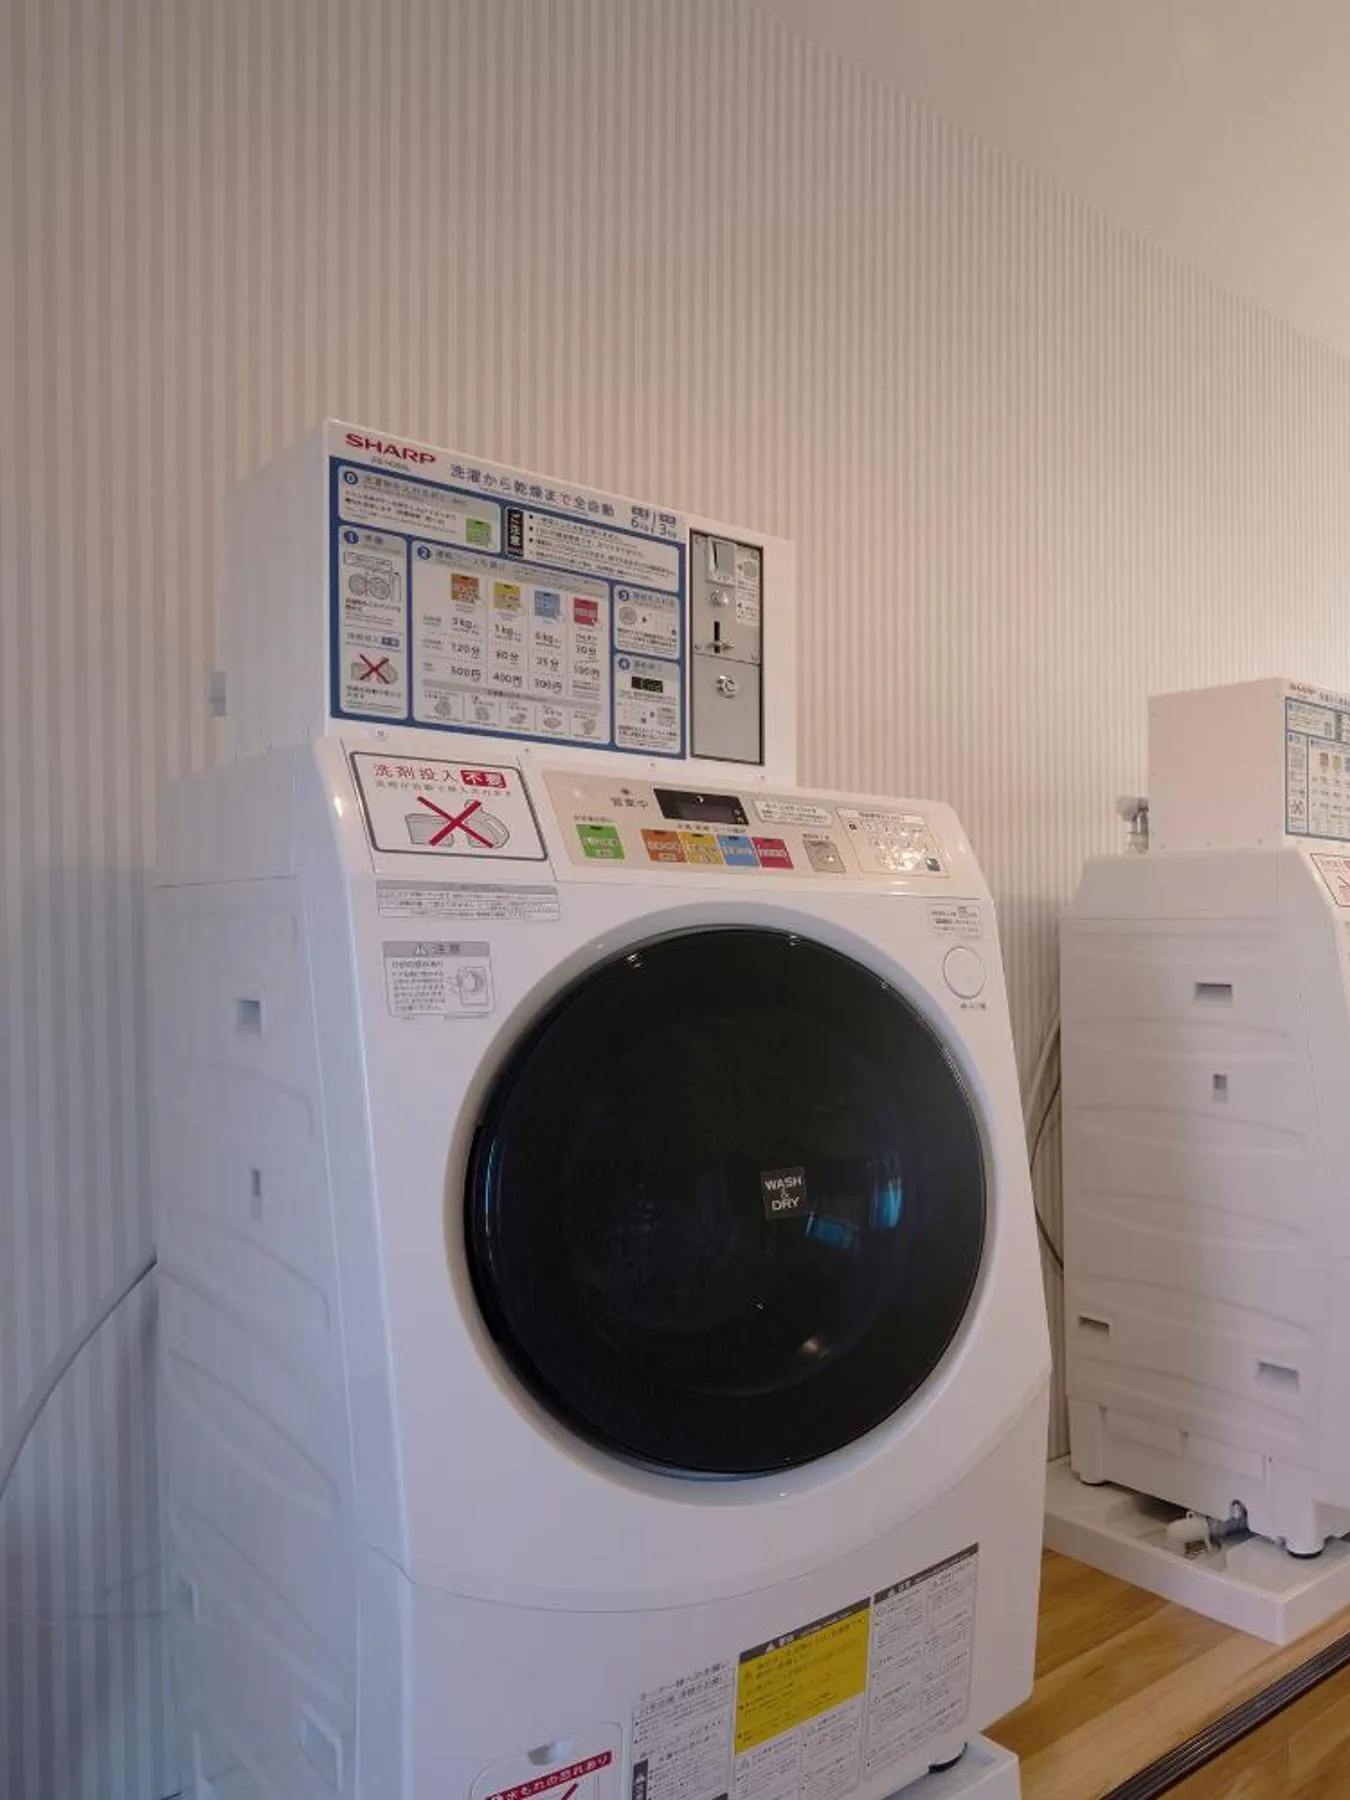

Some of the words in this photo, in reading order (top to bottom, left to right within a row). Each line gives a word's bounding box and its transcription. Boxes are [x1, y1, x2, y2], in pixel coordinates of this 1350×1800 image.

[345, 433, 437, 465] SHARP
[451, 463, 615, 518] 洗濯から乾燥まで全自動
[374, 764, 458, 784] 洗剤投入
[764, 1176, 802, 1190] WASH
[771, 1196, 800, 1210] DRY
